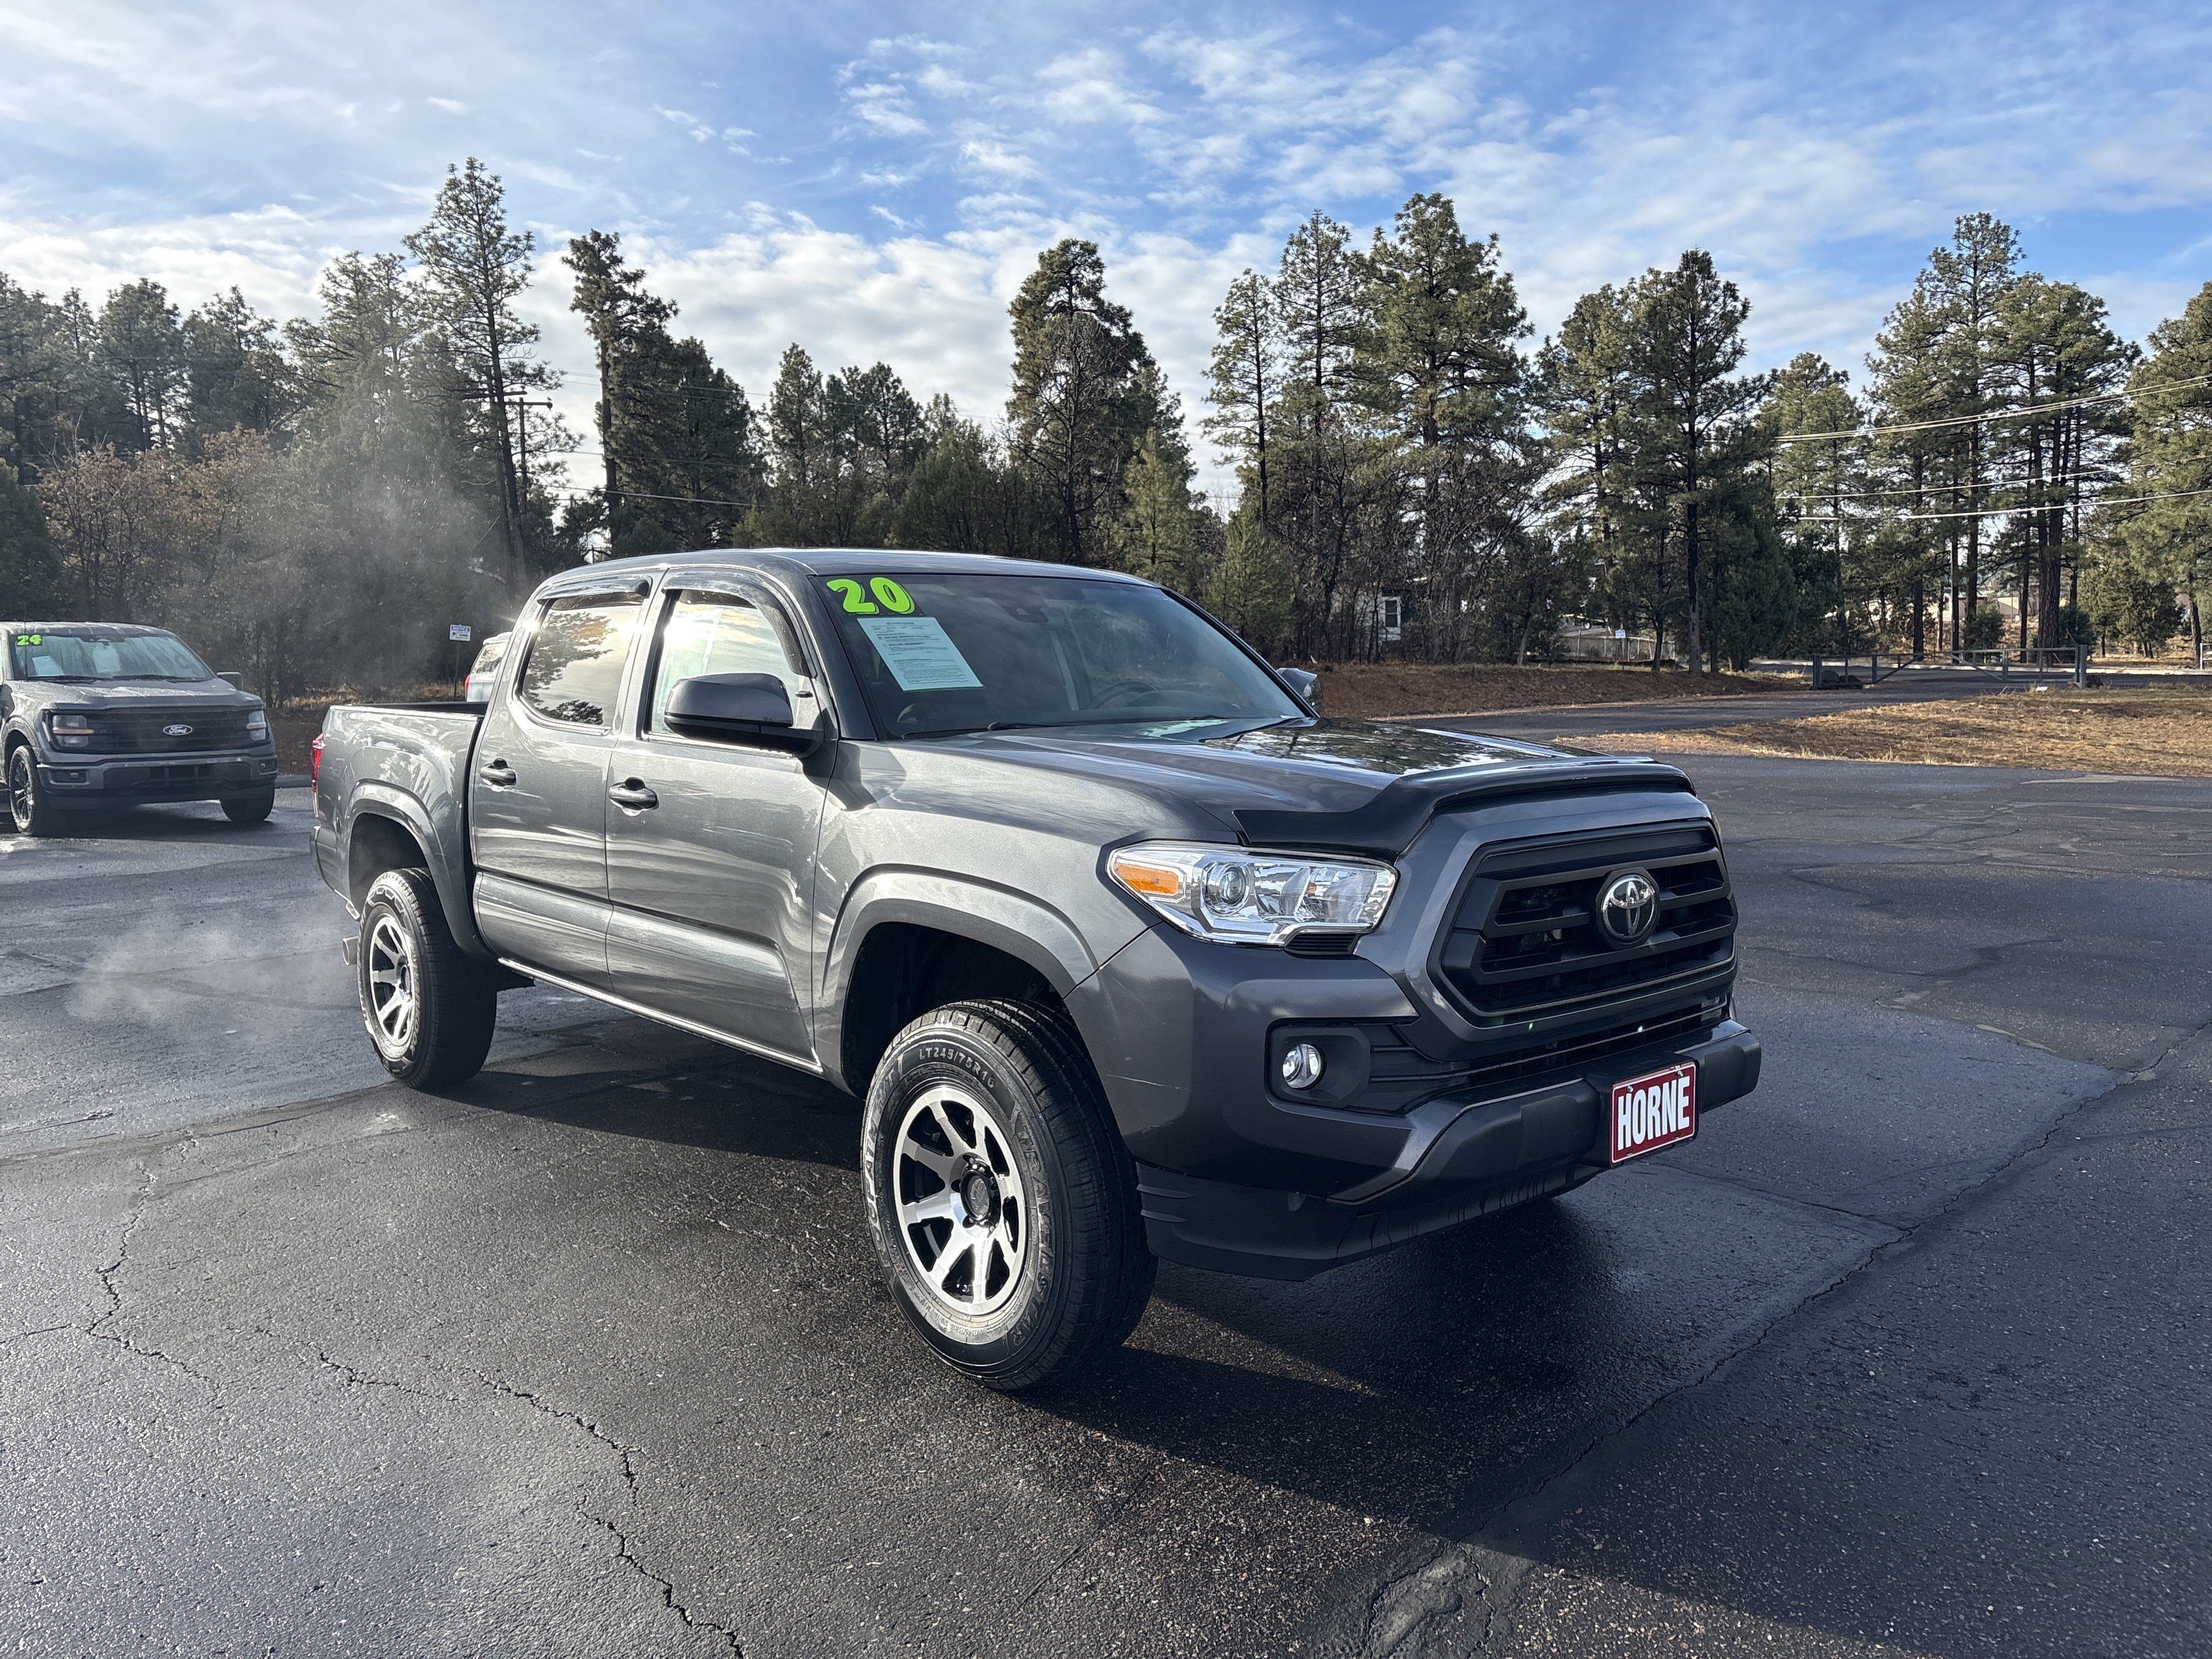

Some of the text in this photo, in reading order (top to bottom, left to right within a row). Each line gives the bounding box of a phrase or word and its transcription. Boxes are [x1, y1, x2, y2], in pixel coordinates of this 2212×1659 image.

[827, 577, 915, 614] 20
[17, 634, 42, 645] 24
[168, 725, 187, 734] Ford
[919, 1047, 995, 1088] LT245/75R16
[1617, 1075, 1690, 1150] HORNE
